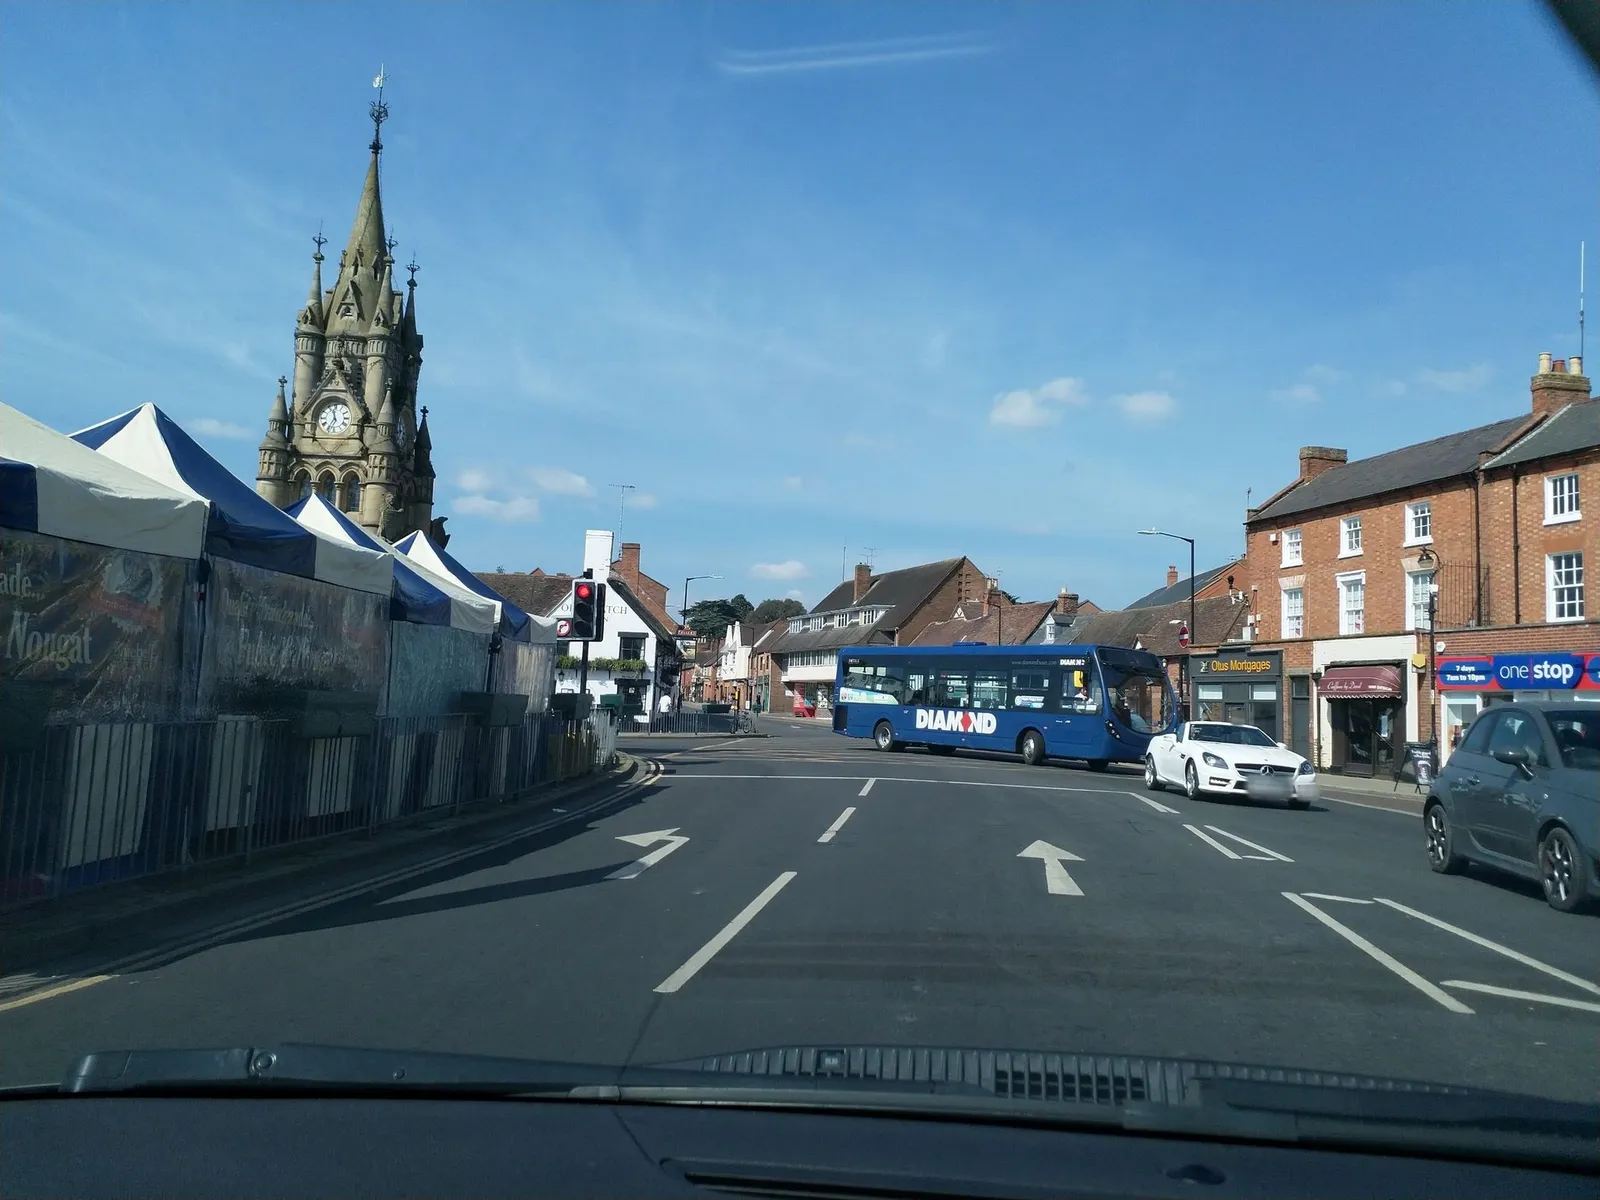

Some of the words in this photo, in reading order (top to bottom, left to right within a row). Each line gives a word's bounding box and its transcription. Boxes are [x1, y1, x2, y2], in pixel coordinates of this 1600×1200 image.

[4, 610, 92, 672] Nougat
[1211, 660, 1229, 671] Otus
[1230, 659, 1271, 673] Mortgages
[1460, 665, 1476, 673] days
[1499, 665, 1529, 679] one
[1533, 660, 1574, 685] stop
[1467, 674, 1486, 682] 10pm
